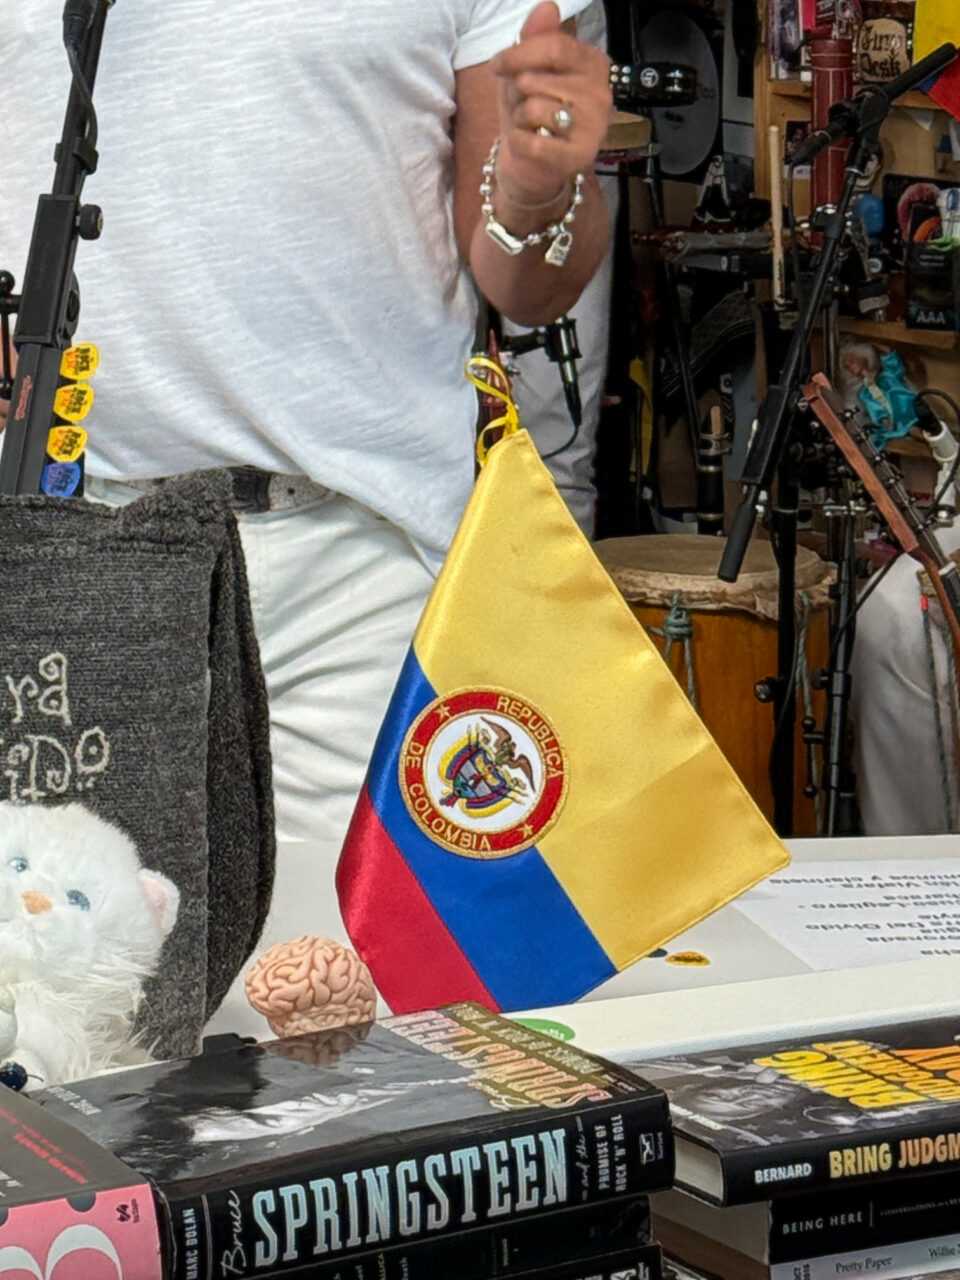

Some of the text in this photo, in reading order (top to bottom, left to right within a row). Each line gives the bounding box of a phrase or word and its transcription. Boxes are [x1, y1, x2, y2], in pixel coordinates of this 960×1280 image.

[496, 695, 564, 780] REPUBLICA
[405, 742, 493, 851] DE COLOMBIA
[752, 1049, 929, 1108] BRING
[611, 1113, 625, 1142] ROLL
[594, 1124, 611, 1190] PROMISE OF
[754, 1162, 813, 1185] BERNARD
[828, 1142, 893, 1179] BRING
[613, 1163, 628, 1192] ROCK
[252, 1127, 568, 1268] SPRINGSTEEN
[181, 1207, 199, 1245] DOLAN
[219, 1189, 247, 1278] Bruce
[782, 1210, 863, 1235] BEING HERE
[835, 1245, 957, 1275] Pretty Paper Willie
